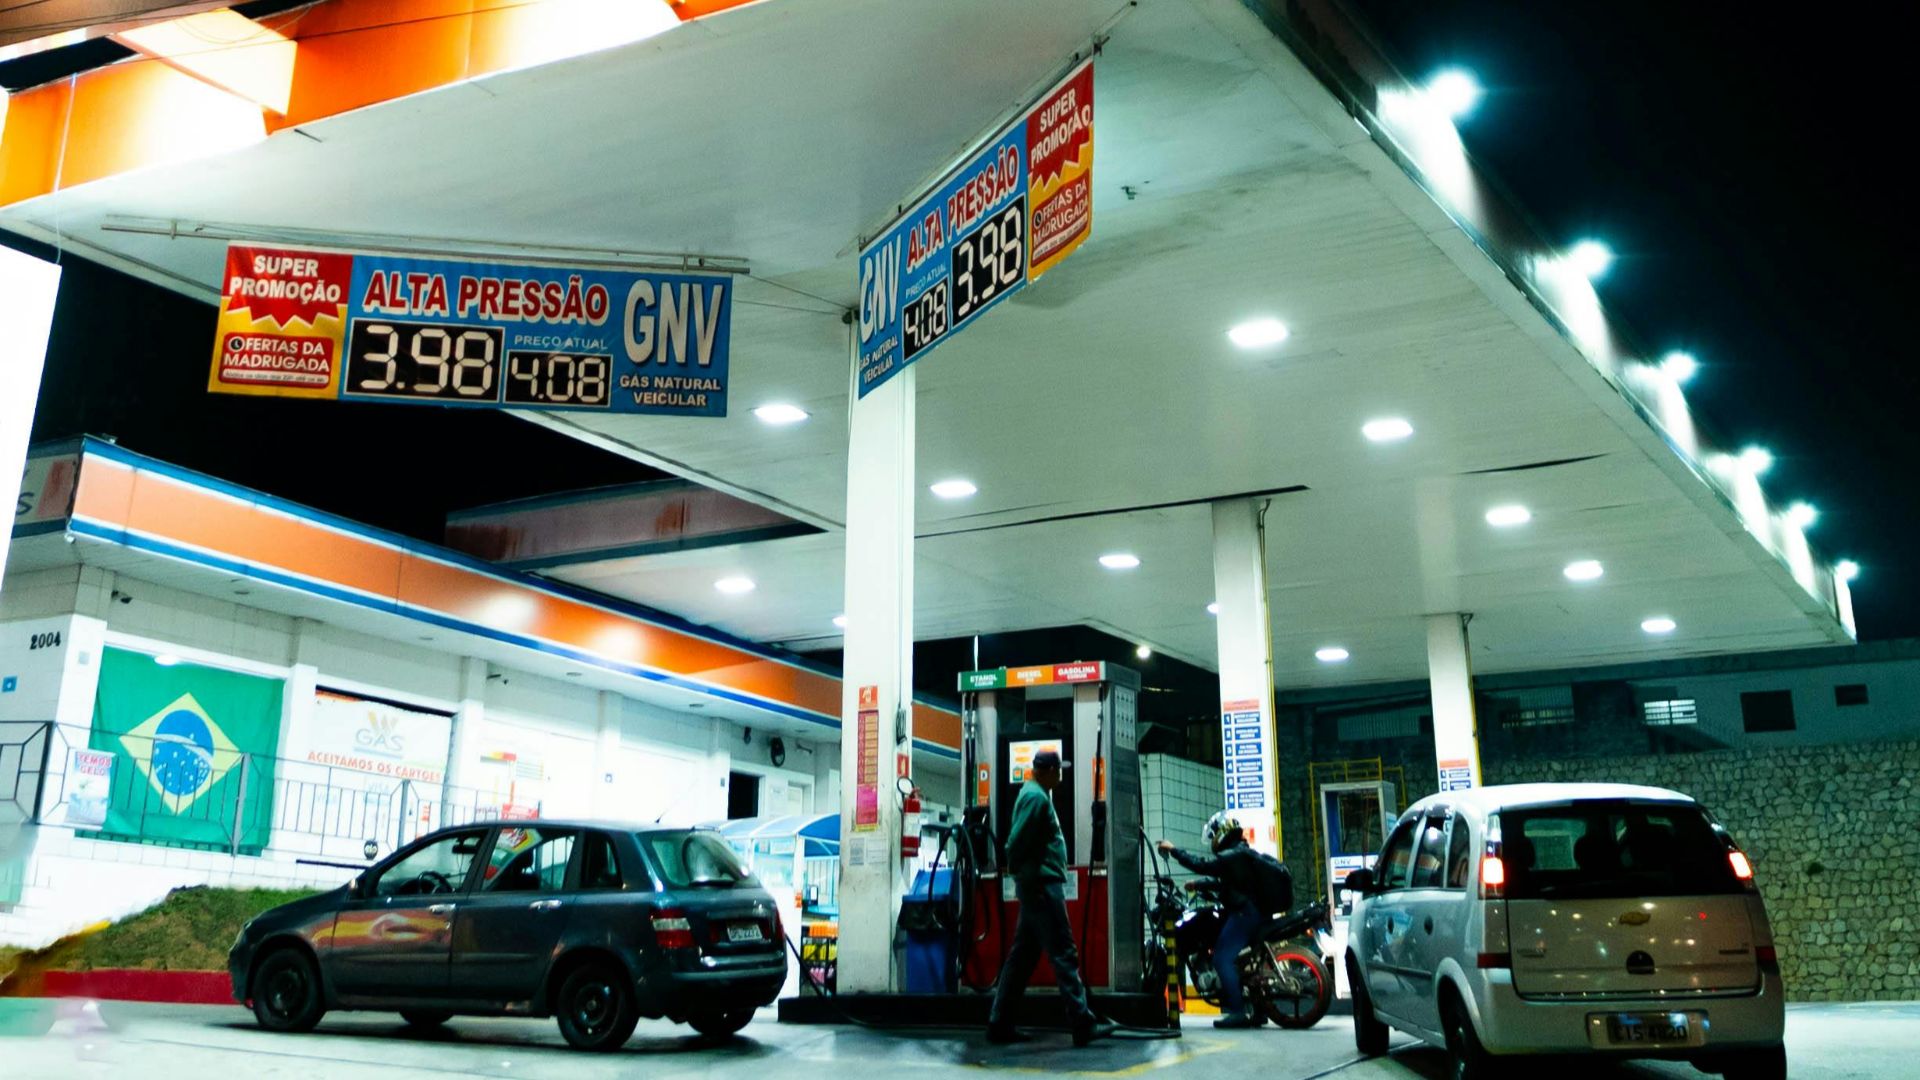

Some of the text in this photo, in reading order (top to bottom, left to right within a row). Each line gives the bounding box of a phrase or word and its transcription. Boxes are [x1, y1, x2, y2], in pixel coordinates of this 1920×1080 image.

[1040, 88, 1076, 132] SUPER
[1031, 104, 1091, 169] PROMOÇÃO
[907, 206, 944, 274] ALTA
[947, 144, 1020, 243] PRESSÃO
[1034, 178, 1087, 229] OFERTAS DA
[1033, 194, 1088, 248] MADRUGADA
[253, 254, 319, 277] SUPER
[958, 206, 1022, 317] 3.98
[229, 276, 341, 305] PROMOÇÃO
[362, 269, 609, 326] ALTA PRESSÃO
[860, 233, 901, 343] GNV
[623, 279, 724, 366] GNV
[905, 282, 947, 347] 4.08
[228, 336, 325, 356] OFERTAS DA
[514, 335, 609, 350] PREÇO ATUAL
[223, 353, 331, 373] MADRUGADA
[360, 324, 496, 396] 3.98
[864, 354, 894, 384] VEICULAR
[511, 355, 606, 403] 4.08
[653, 375, 722, 391] NATURAL
[633, 392, 706, 406] VEICULAR
[30, 631, 61, 650] 2004
[970, 674, 998, 683] ETANOL
[1017, 670, 1043, 679] DIESEL
[1058, 666, 1096, 676] GASOLINA
[355, 728, 404, 751] GAS
[80, 765, 105, 777] GELO
[307, 750, 373, 771] ACEITAMOS
[376, 761, 391, 774] OS
[980, 769, 989, 781] D
